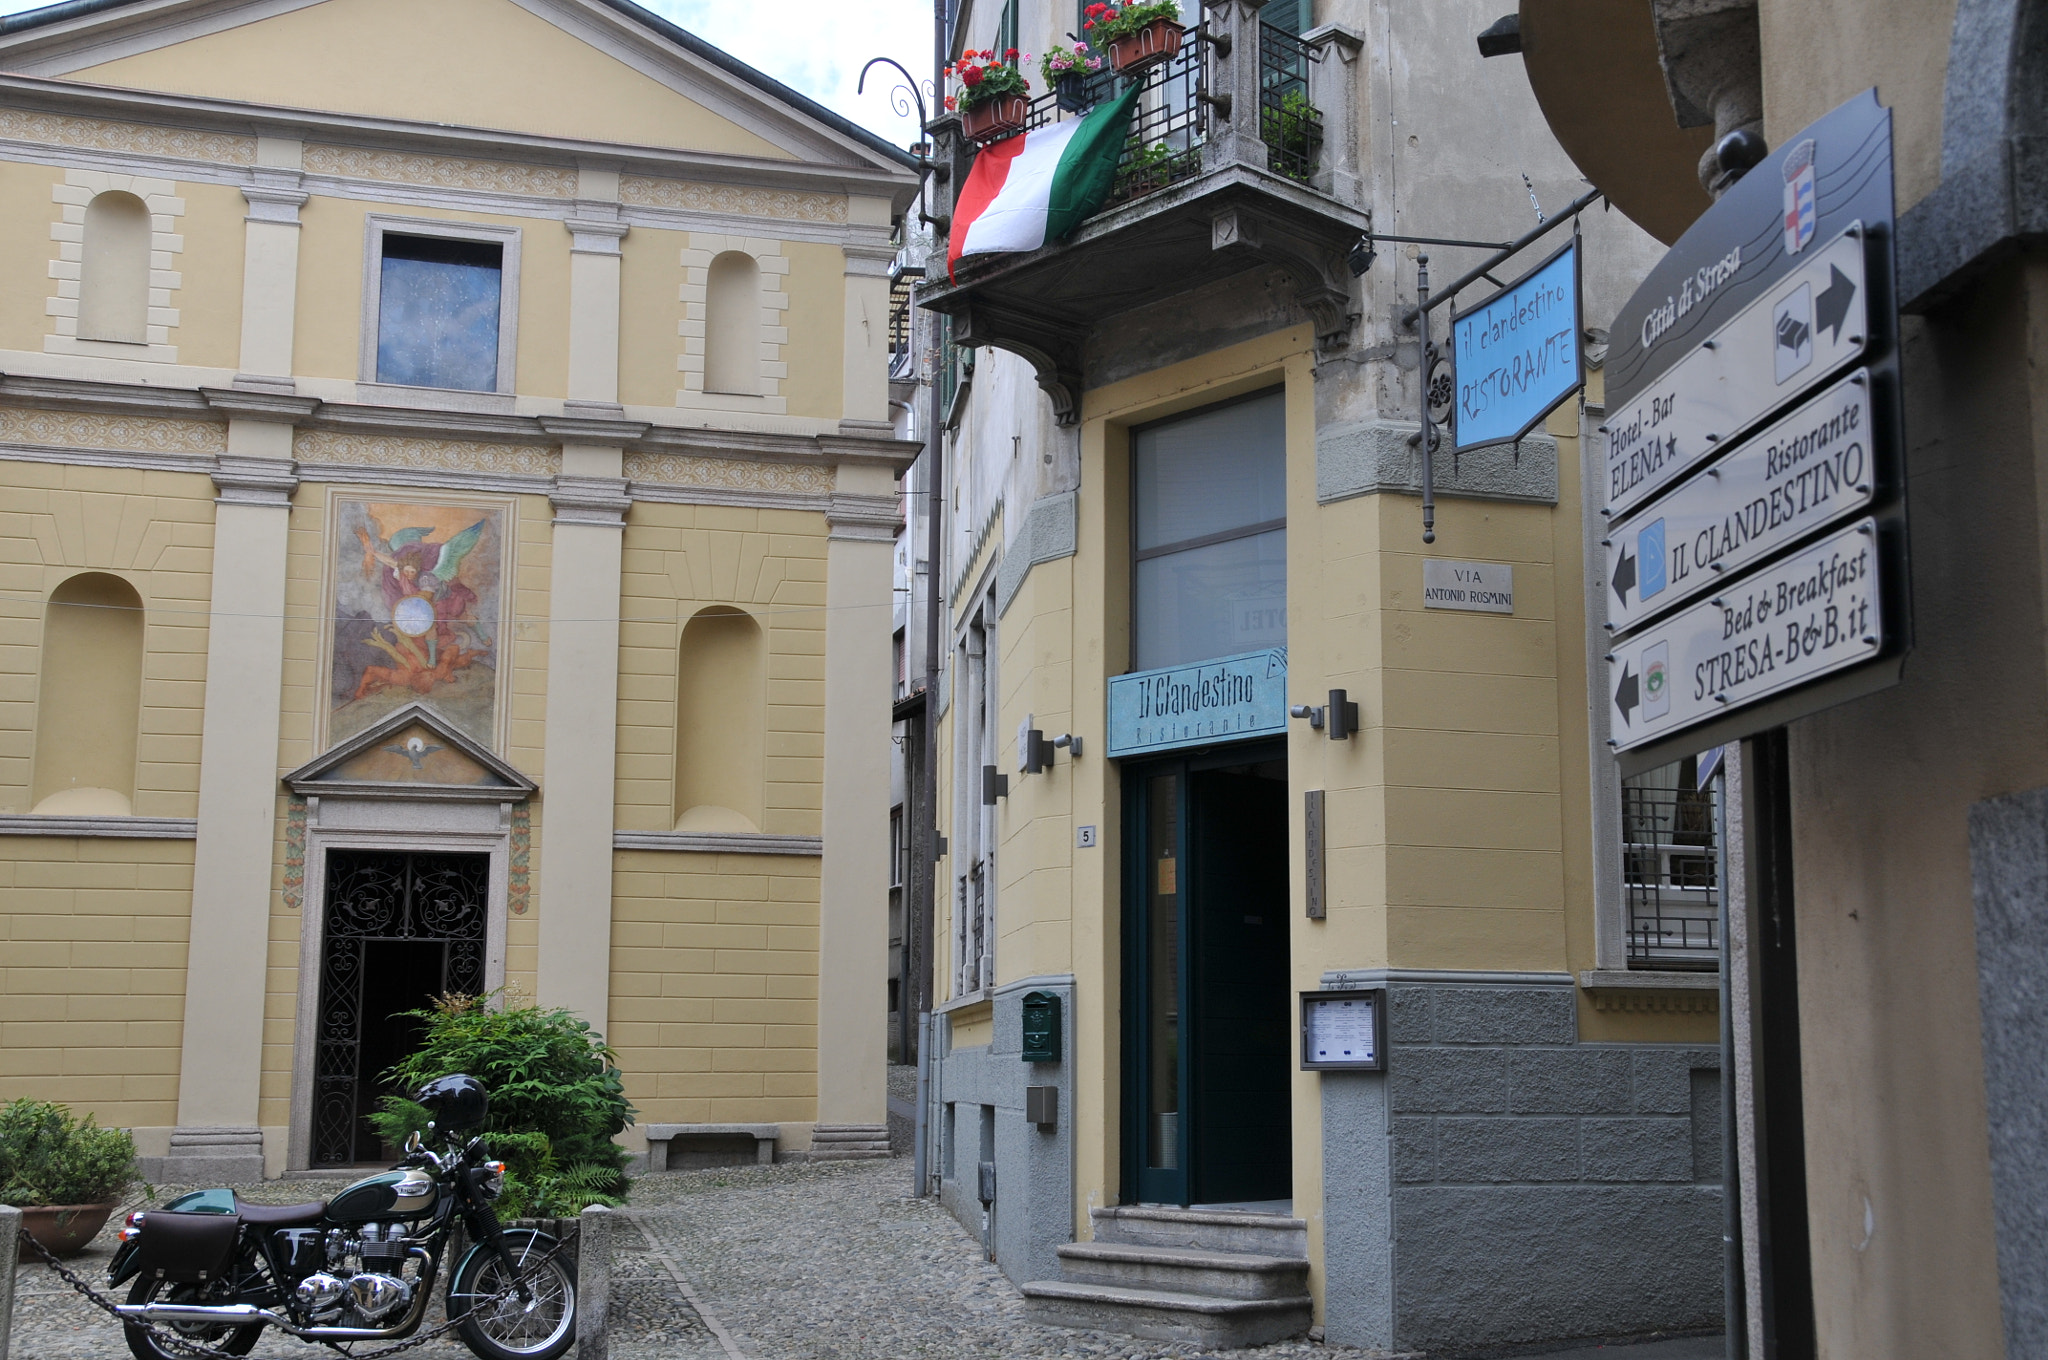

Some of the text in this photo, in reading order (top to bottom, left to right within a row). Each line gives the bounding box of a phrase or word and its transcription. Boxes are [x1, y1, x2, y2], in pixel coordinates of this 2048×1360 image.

[1464, 283, 1565, 360] il clandestino
[1642, 246, 1741, 348] Città di Stresa
[1462, 328, 1573, 424] RISTORANTE
[1610, 434, 1664, 503] ELENA
[1765, 403, 1859, 481] Ristorante
[1672, 442, 1863, 584] IL CLANDESTINO
[1425, 588, 1512, 606] ANTONIO ROSMINI
[1454, 569, 1482, 583] VIA
[1722, 548, 1867, 640] Bed & Breakfast
[1136, 713, 1255, 745] Ristorante
[1139, 667, 1253, 719] Il Clandestino
[1083, 830, 1089, 842] 5
